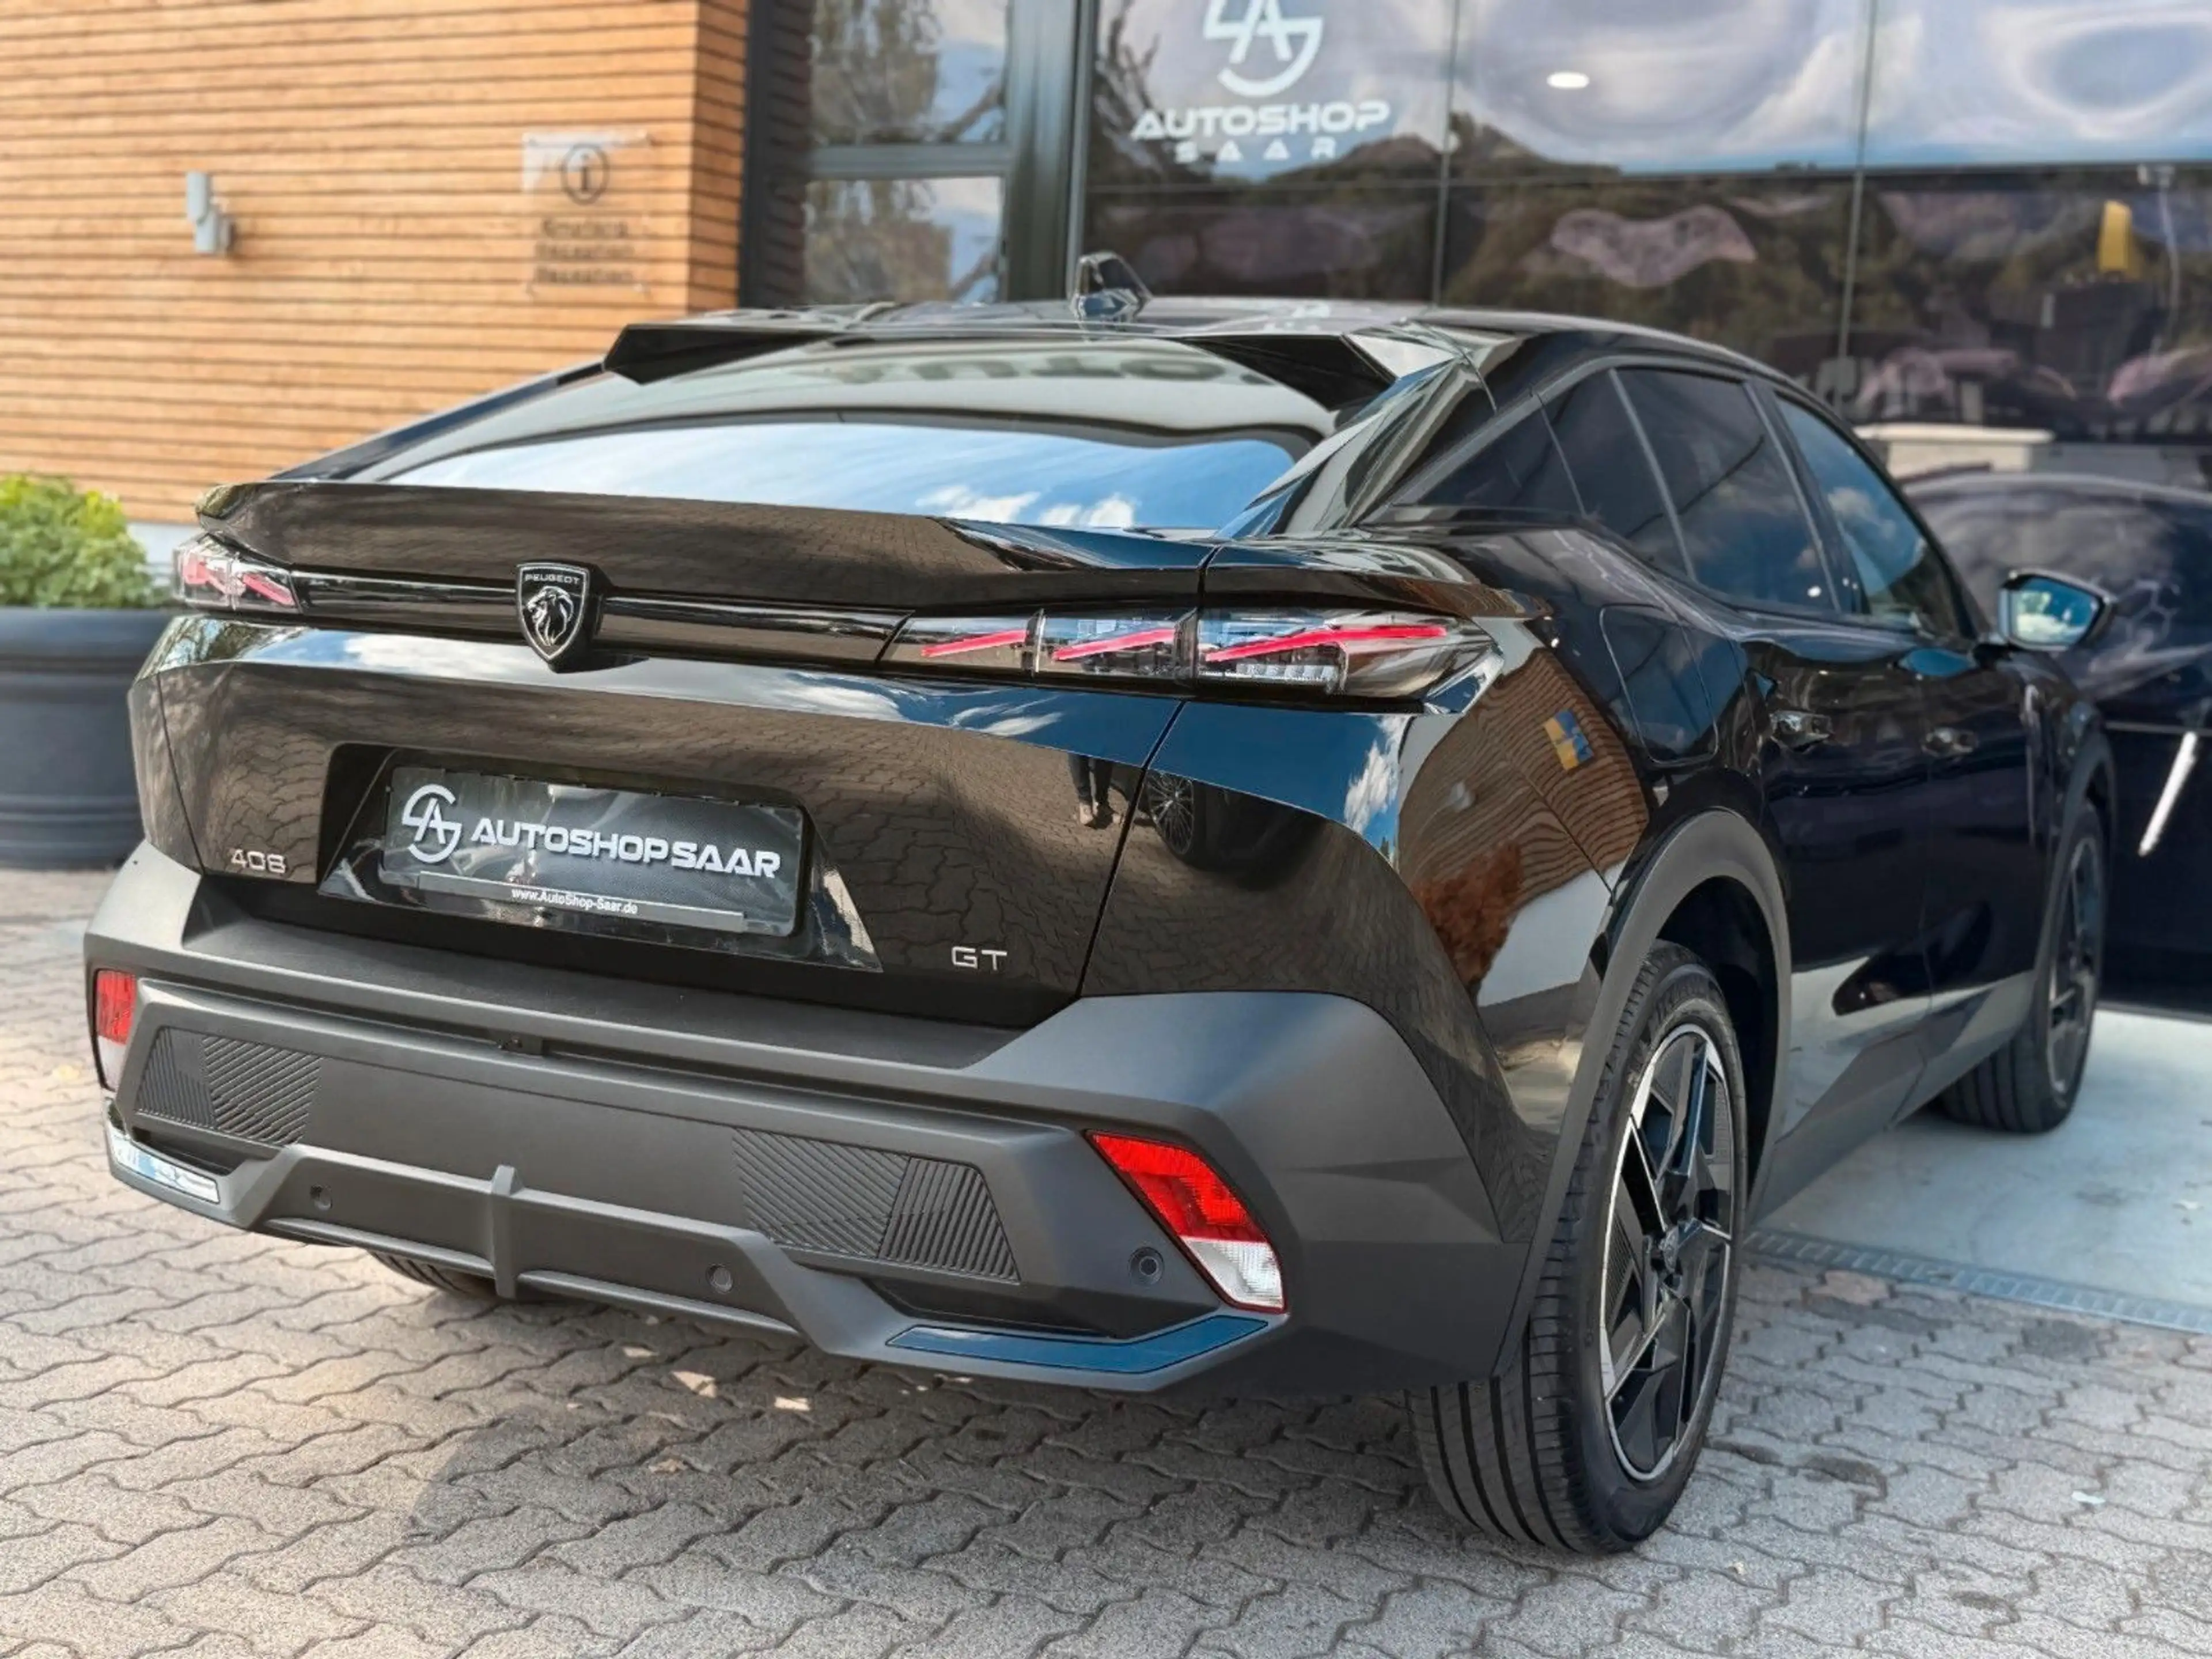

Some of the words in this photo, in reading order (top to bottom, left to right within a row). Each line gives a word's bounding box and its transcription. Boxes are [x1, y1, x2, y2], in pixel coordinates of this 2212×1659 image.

[1130, 100, 1391, 141] AUTOSHOP
[525, 573, 581, 585] PEUGEOT
[231, 849, 286, 873] 408
[511, 888, 638, 915] www.AutoShop-Saar.de
[952, 946, 1007, 971] GT
